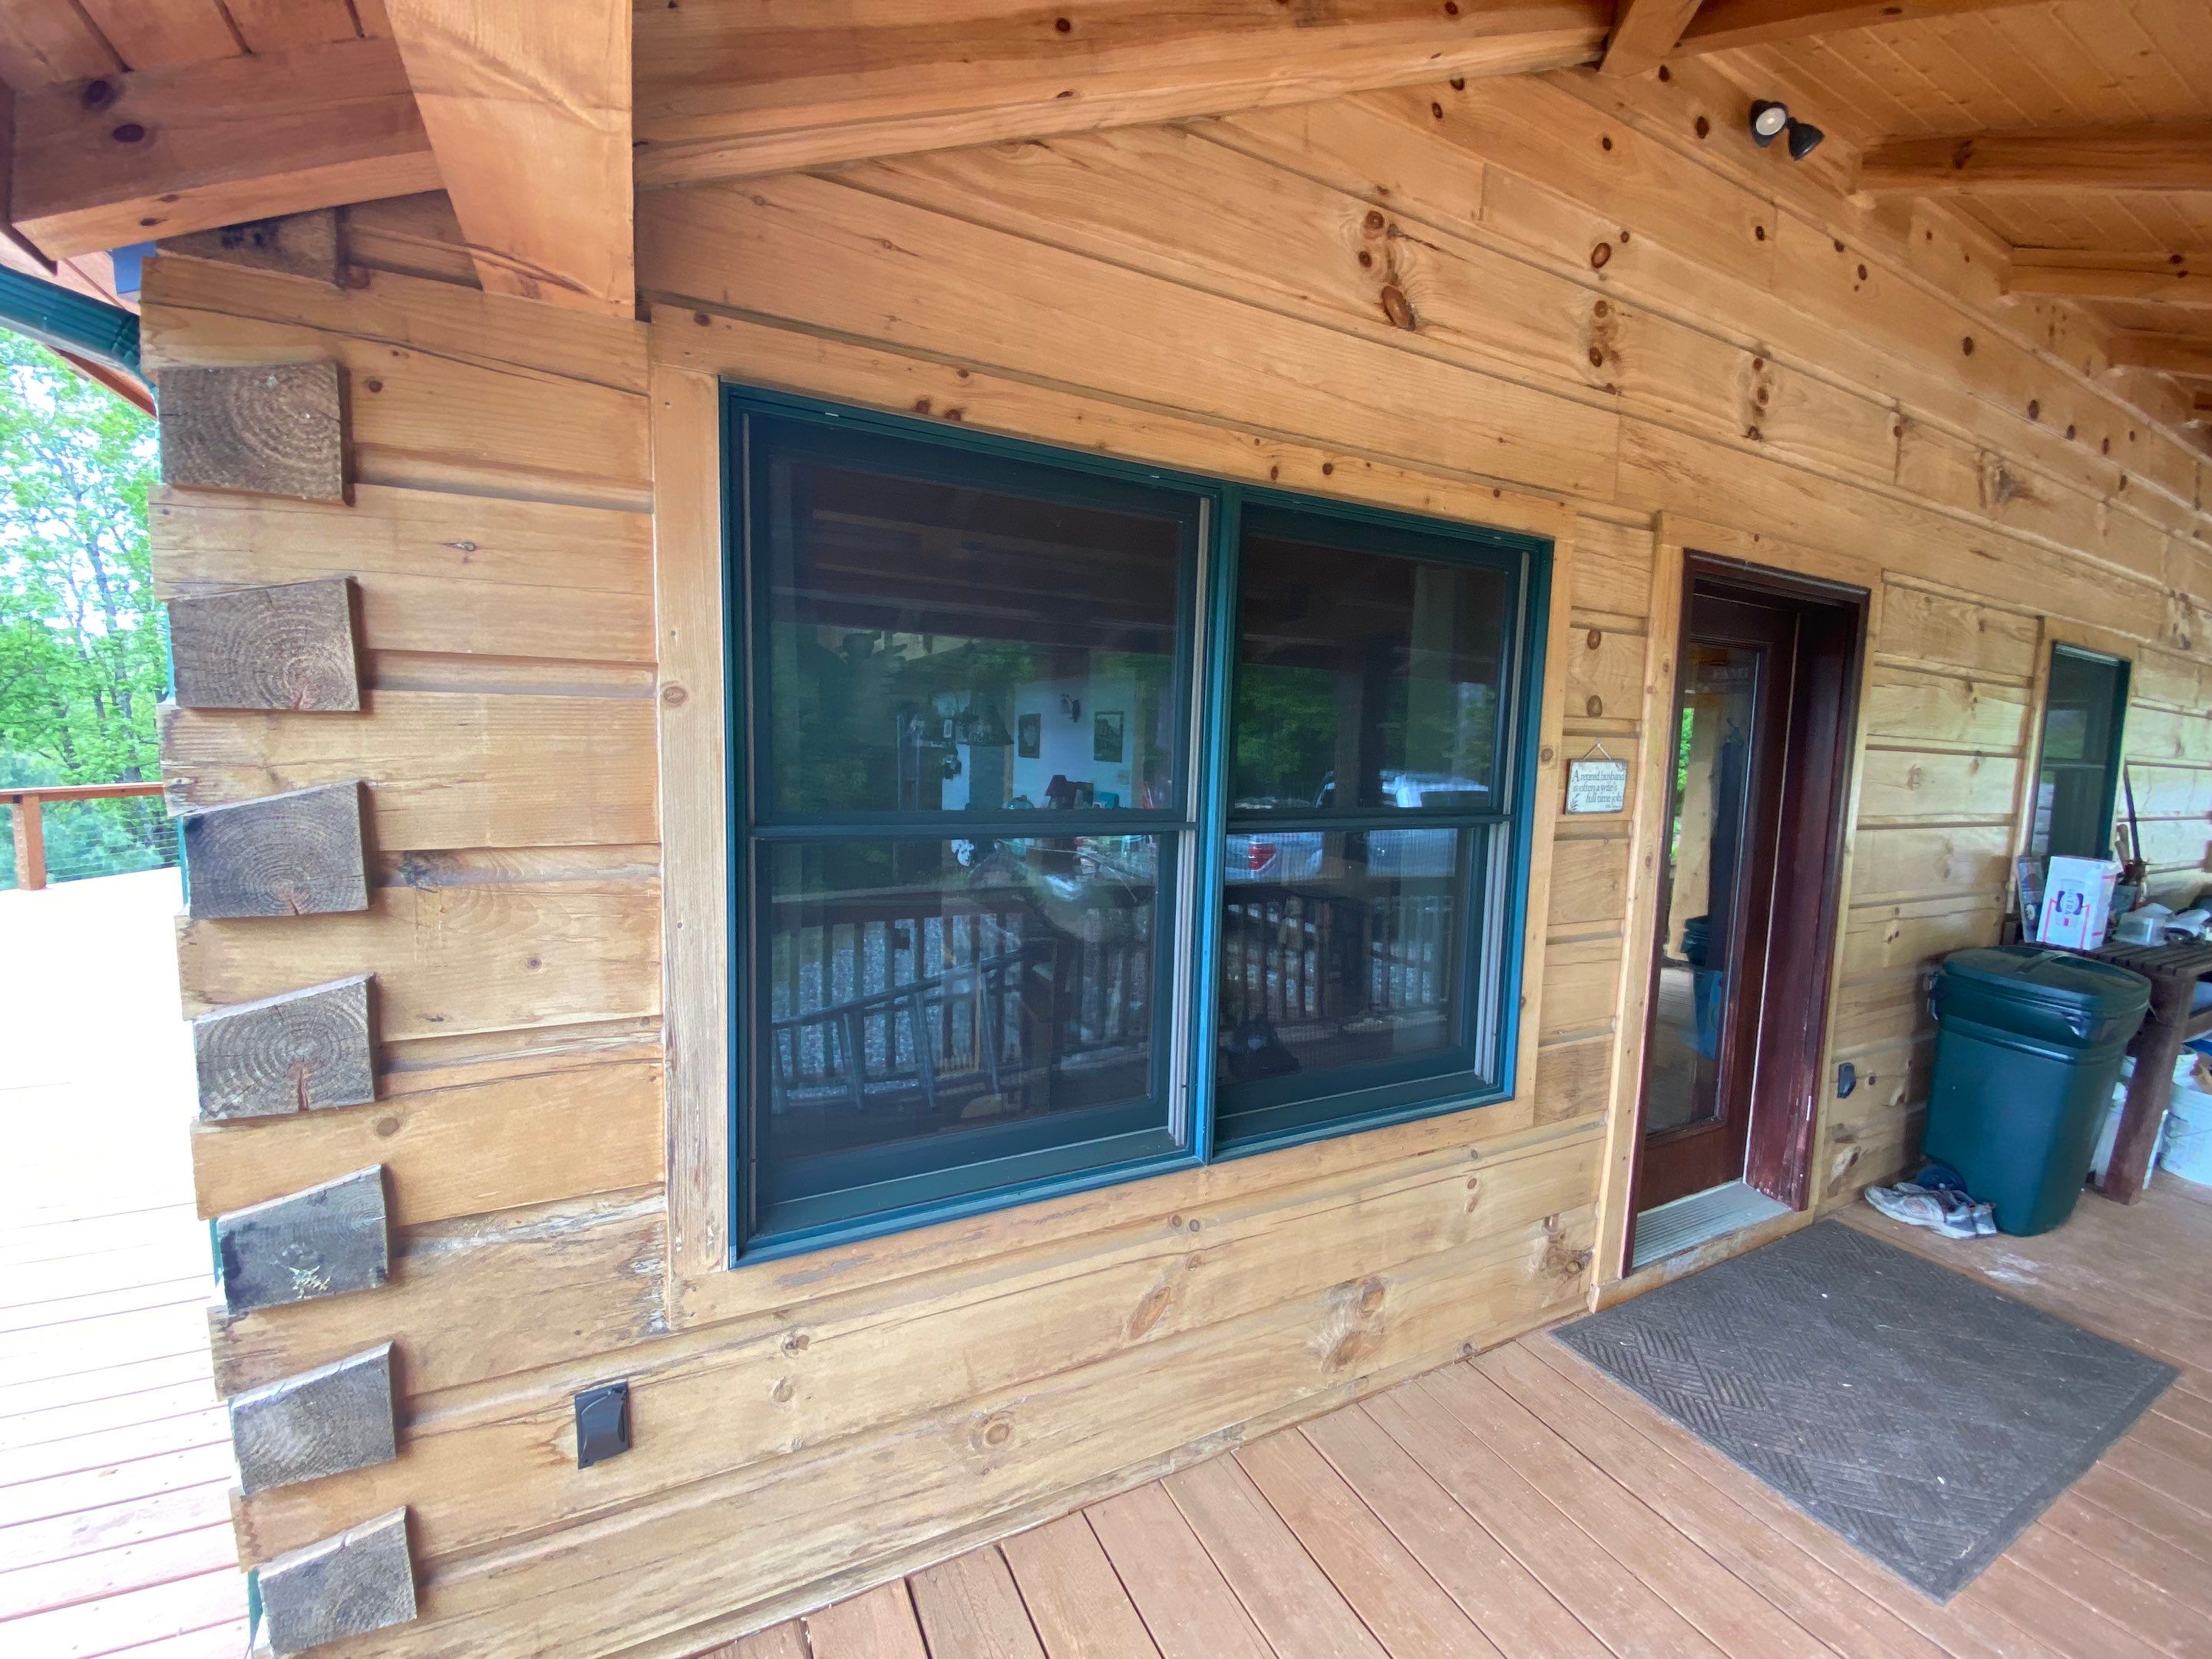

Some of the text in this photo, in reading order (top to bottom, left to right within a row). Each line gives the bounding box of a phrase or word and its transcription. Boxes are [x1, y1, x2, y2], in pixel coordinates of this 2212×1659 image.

[1572, 768, 1624, 782] A retired husband
[1579, 781, 1596, 792] often
[1586, 792, 1597, 803] full
